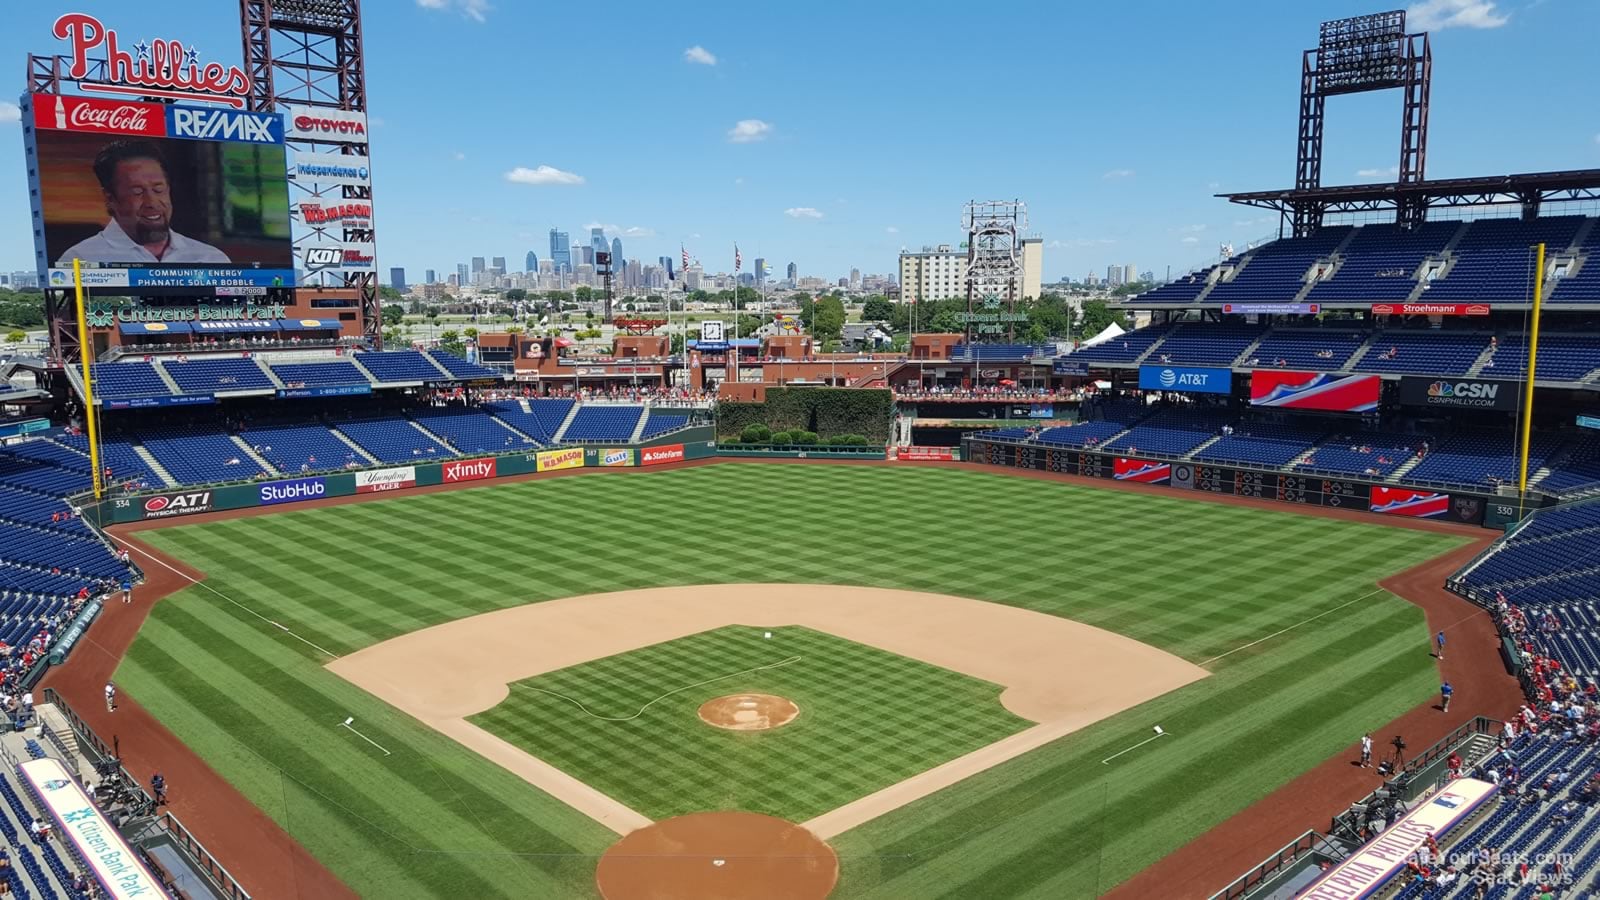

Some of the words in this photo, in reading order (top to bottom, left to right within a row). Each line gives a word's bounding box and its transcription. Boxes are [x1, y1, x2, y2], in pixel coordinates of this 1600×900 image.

[53, 12, 250, 96] Phillies
[71, 102, 151, 131] Coca-Cola
[174, 108, 276, 142] RE/MAX
[313, 118, 365, 135] TOYOTA
[297, 163, 358, 178] Independence
[306, 248, 343, 264] KDI
[149, 269, 204, 277] COMMUNITY
[208, 269, 243, 277] ENERGY
[118, 305, 195, 322] Citizens
[198, 304, 244, 321] Bank
[247, 302, 287, 320] Park
[1000, 310, 1029, 321] Bank
[1403, 304, 1456, 313] Stroehmann
[978, 323, 1003, 334] Park
[1178, 373, 1208, 386] AT&T
[1454, 382, 1499, 398] CSN
[1427, 396, 1496, 408] CSNPHILLY.COM
[526, 454, 536, 462] 374
[605, 452, 628, 464] Gulf
[363, 469, 408, 483] Yuengling
[447, 461, 492, 481] xfinity
[261, 482, 325, 501] StubHub
[373, 482, 400, 491] LAGER
[116, 499, 130, 508] 334
[167, 492, 210, 509] ATI
[146, 509, 178, 518] PHYSICAL
[179, 505, 208, 514] THERAPY
[1496, 506, 1513, 516] 330
[1366, 819, 1436, 863] PHILLIES
[77, 820, 111, 854] Citizens
[101, 851, 129, 877] Bank
[117, 872, 148, 899] Park
